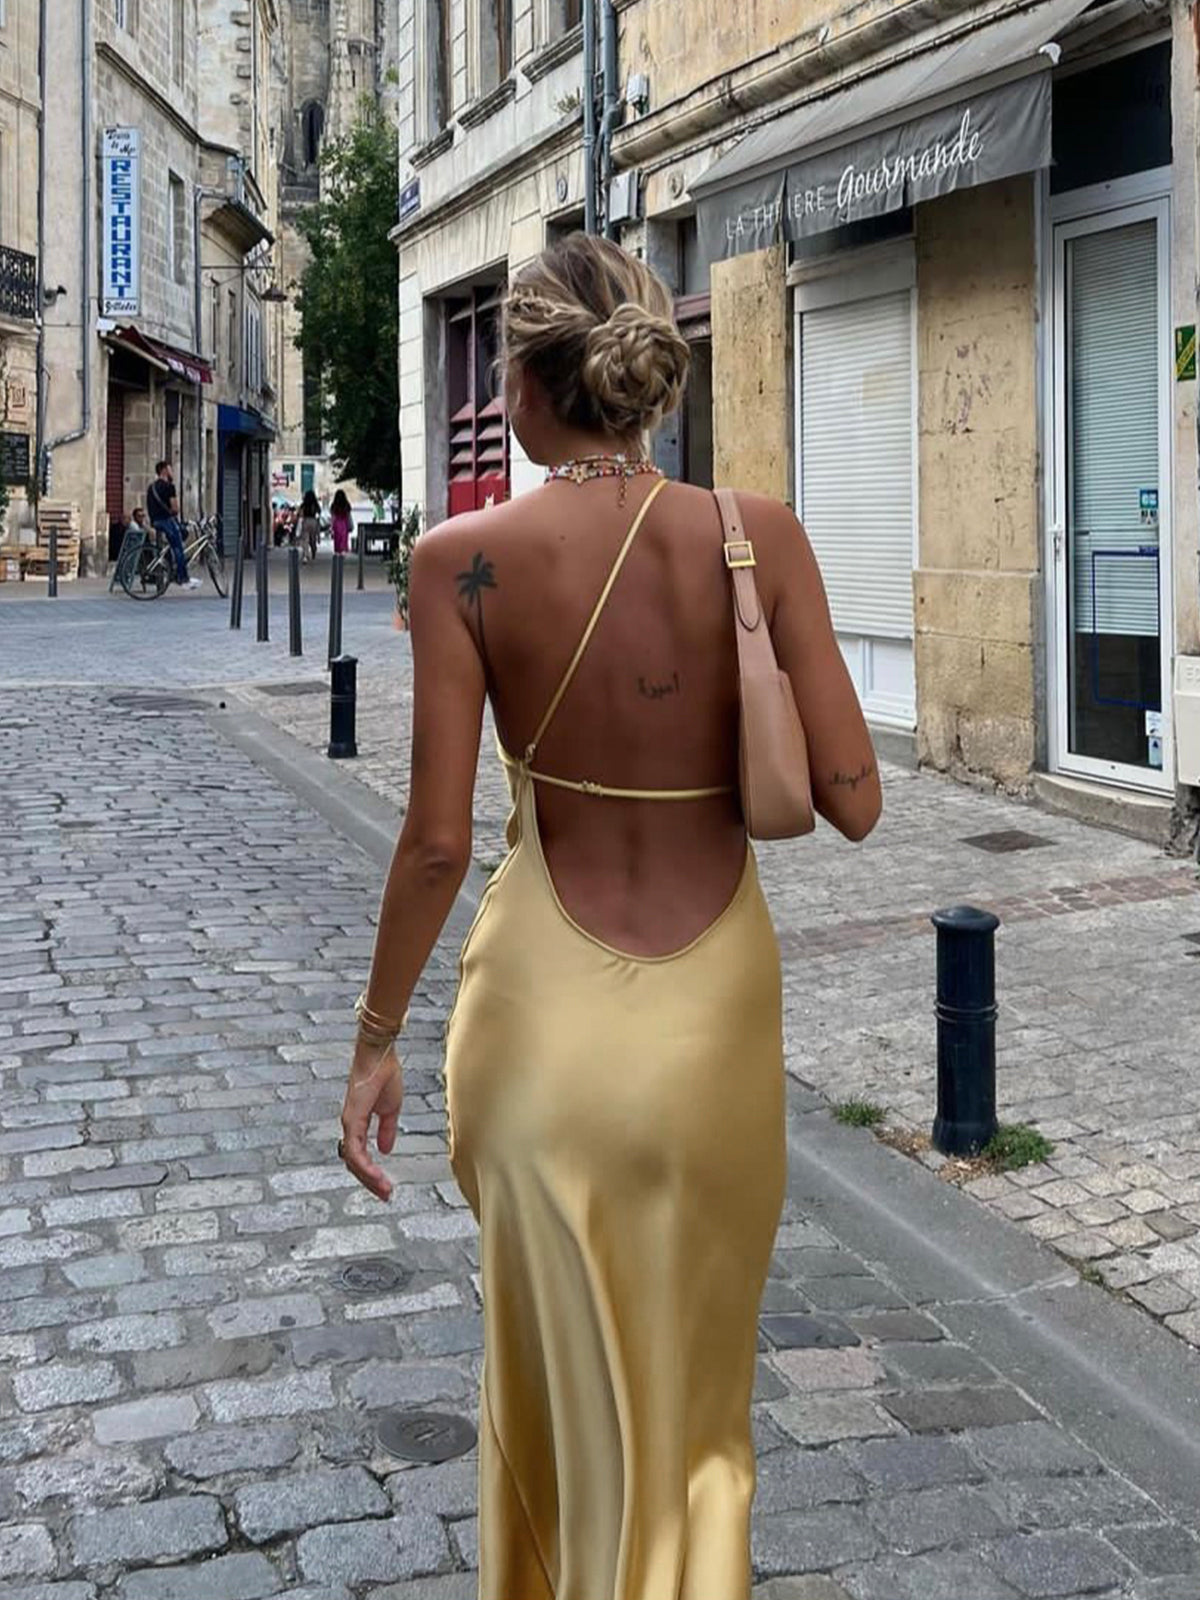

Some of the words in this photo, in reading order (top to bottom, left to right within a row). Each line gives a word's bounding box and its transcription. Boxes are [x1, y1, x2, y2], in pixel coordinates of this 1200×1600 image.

[110, 159, 132, 298] RESTAURANT
[726, 216, 745, 240] LA
[836, 107, 984, 223] Gourmande
